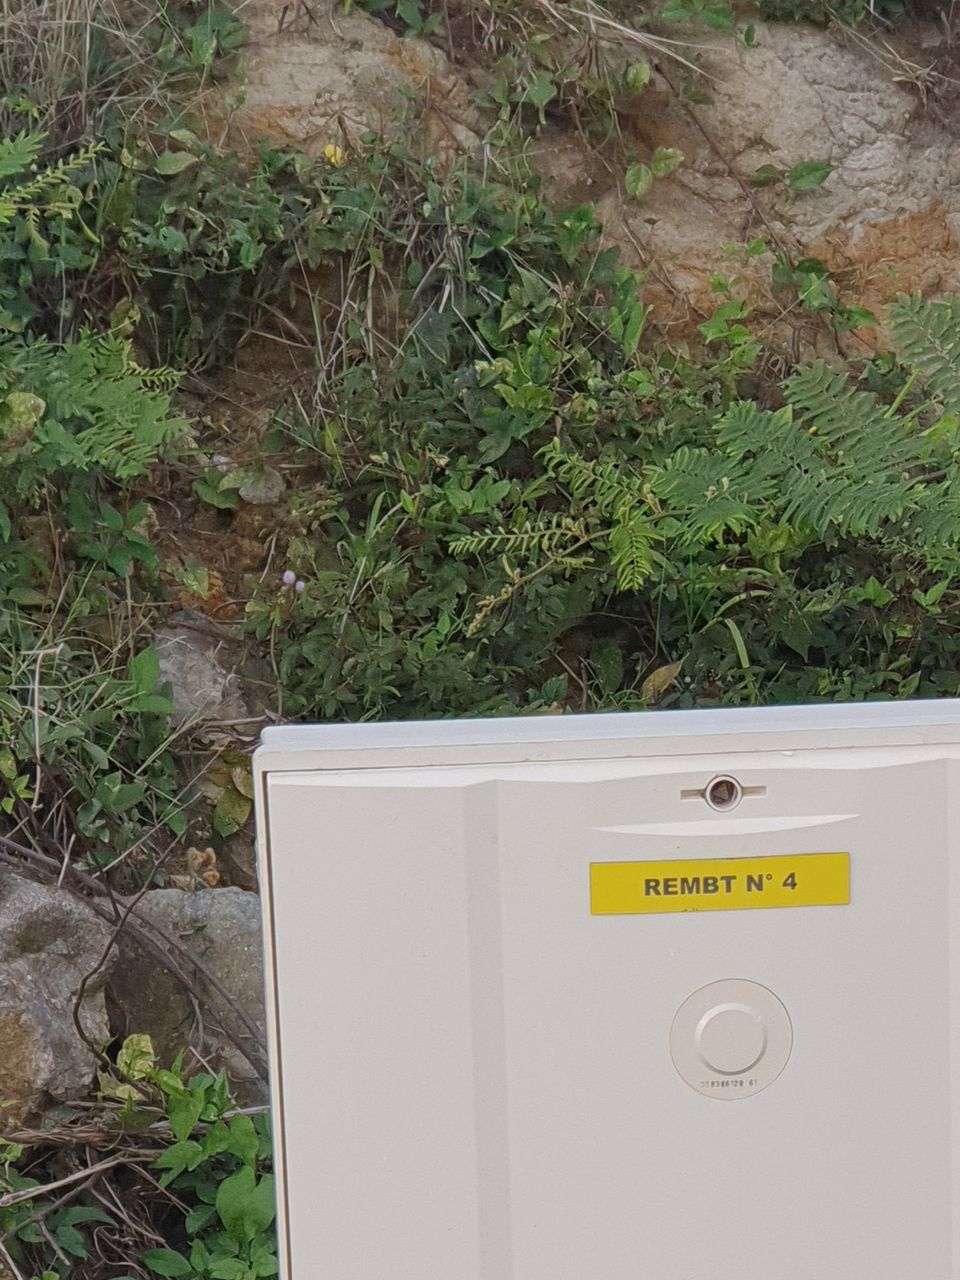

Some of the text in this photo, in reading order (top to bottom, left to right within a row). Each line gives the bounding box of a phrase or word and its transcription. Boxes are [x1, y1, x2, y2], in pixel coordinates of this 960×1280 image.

[644, 872, 797, 896] REMBT N° 4
